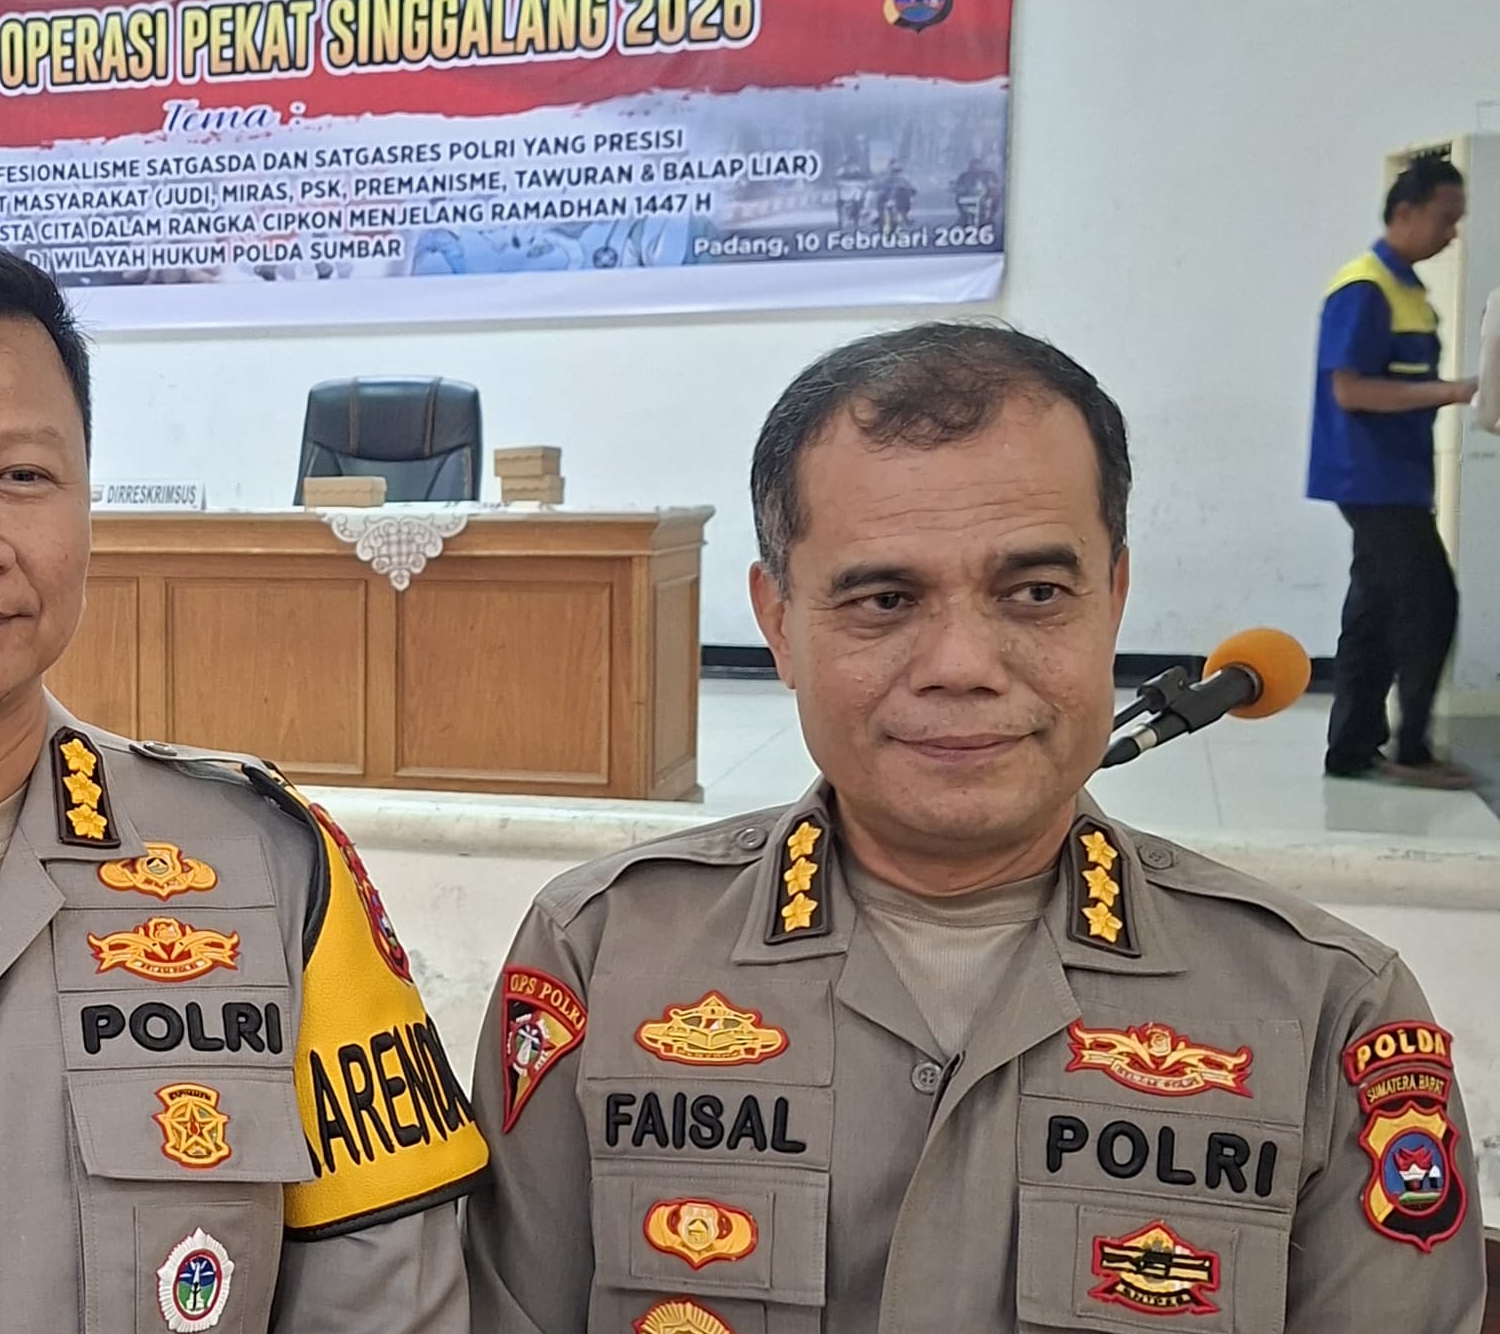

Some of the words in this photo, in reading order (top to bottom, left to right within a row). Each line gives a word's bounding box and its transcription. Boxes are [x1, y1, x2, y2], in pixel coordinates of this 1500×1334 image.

[0, 8, 169, 90] OPERASI
[163, 99, 273, 133] Tema
[147, 154, 252, 177] SATGASDA
[263, 151, 308, 170] DAN
[315, 143, 442, 168] SATGASRES
[450, 139, 515, 160] POLRI
[523, 135, 586, 157] YANG
[594, 129, 683, 153] PRESISI
[13, 188, 148, 212] MASYARAKAT
[155, 186, 215, 208] (JUDI,
[222, 182, 294, 204] MIRAS,
[300, 179, 347, 201] PSK,
[355, 171, 507, 196] PREMANISME,
[515, 165, 632, 188] TAWURAN
[641, 164, 654, 182] &
[663, 158, 743, 181] BALAP
[750, 154, 819, 176] LIAR)
[41, 220, 88, 240] CITA
[91, 217, 161, 238] DALAM
[169, 213, 256, 235] RANGKA
[263, 210, 342, 232] CIPKON
[350, 203, 483, 228] MENJELANG
[491, 197, 627, 221] RAMADHAN
[635, 194, 687, 215] 1447
[695, 193, 711, 212] H
[54, 247, 145, 268] WILAYAH
[152, 244, 226, 265] HUKUM
[232, 242, 302, 263] POLDA
[310, 239, 401, 260] SUMBAR
[693, 235, 789, 258] Padang,
[795, 234, 820, 253] 10
[827, 228, 928, 250] Februari
[935, 225, 995, 247] 2026
[510, 973, 538, 995] OPS
[538, 981, 586, 1030] POLRI
[80, 1001, 283, 1055] POLRI
[1356, 1028, 1446, 1073] POLDA
[1366, 1074, 1417, 1103] SUMATERA
[605, 1091, 806, 1153] FAISAL
[1046, 1114, 1278, 1197] POLRI
